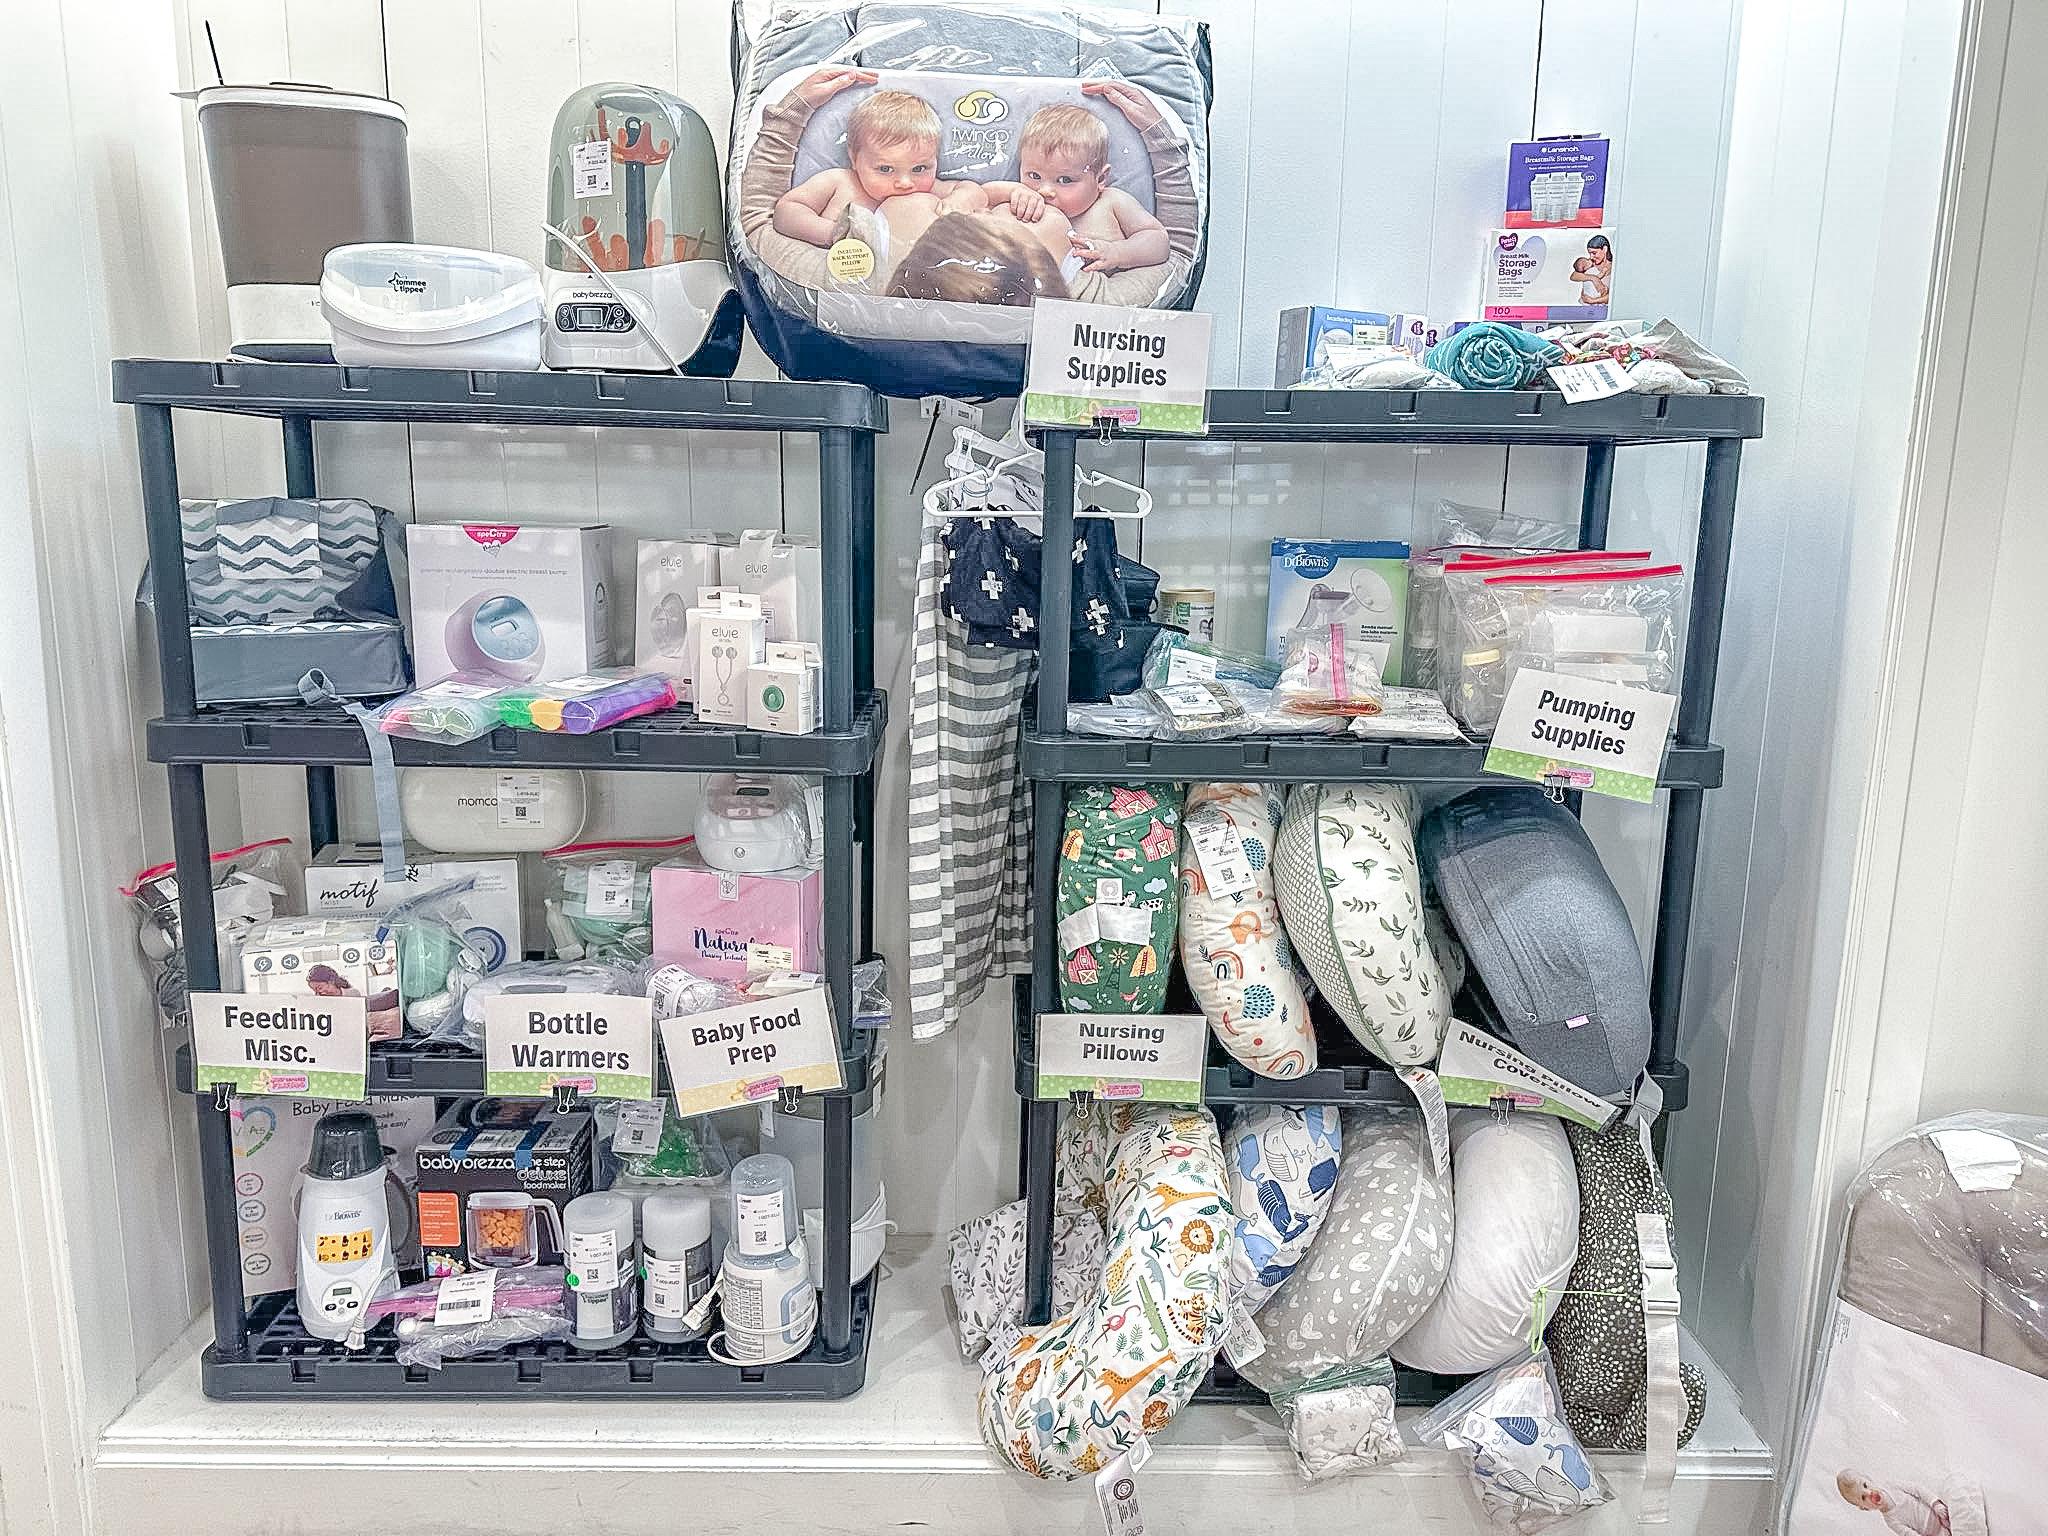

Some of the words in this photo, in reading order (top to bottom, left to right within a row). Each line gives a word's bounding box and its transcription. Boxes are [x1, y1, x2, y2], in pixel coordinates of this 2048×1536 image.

[1499, 259, 1537, 269] Storage
[1499, 268, 1522, 277] Bags
[396, 279, 427, 287] tommee
[400, 286, 424, 294] tippee
[1494, 307, 1511, 315] 100
[1073, 324, 1165, 358] Nursing
[1067, 356, 1167, 388] Supplies
[660, 556, 682, 568] elvie
[745, 562, 768, 574] elvie
[712, 626, 739, 639] elvie
[1538, 690, 1635, 730] Pumping
[1531, 719, 1625, 754] Supplies
[320, 879, 379, 909] motif
[224, 1006, 332, 1036] Feeding
[528, 1012, 608, 1036] Bottle
[691, 1024, 744, 1047] Baby
[750, 1007, 802, 1036] Food
[1079, 1022, 1165, 1043] Nursing
[245, 1038, 316, 1064] Misc.
[511, 1044, 630, 1070] Warmers
[728, 1041, 777, 1066] Prep
[1082, 1043, 1159, 1062] Pillows
[1459, 1031, 1536, 1074] Nursing
[1541, 1073, 1601, 1107] Pillow
[1493, 1058, 1559, 1094] Covers
[292, 1101, 329, 1116] Baby
[543, 1157, 566, 1168] step
[516, 1167, 567, 1181] deluxe
